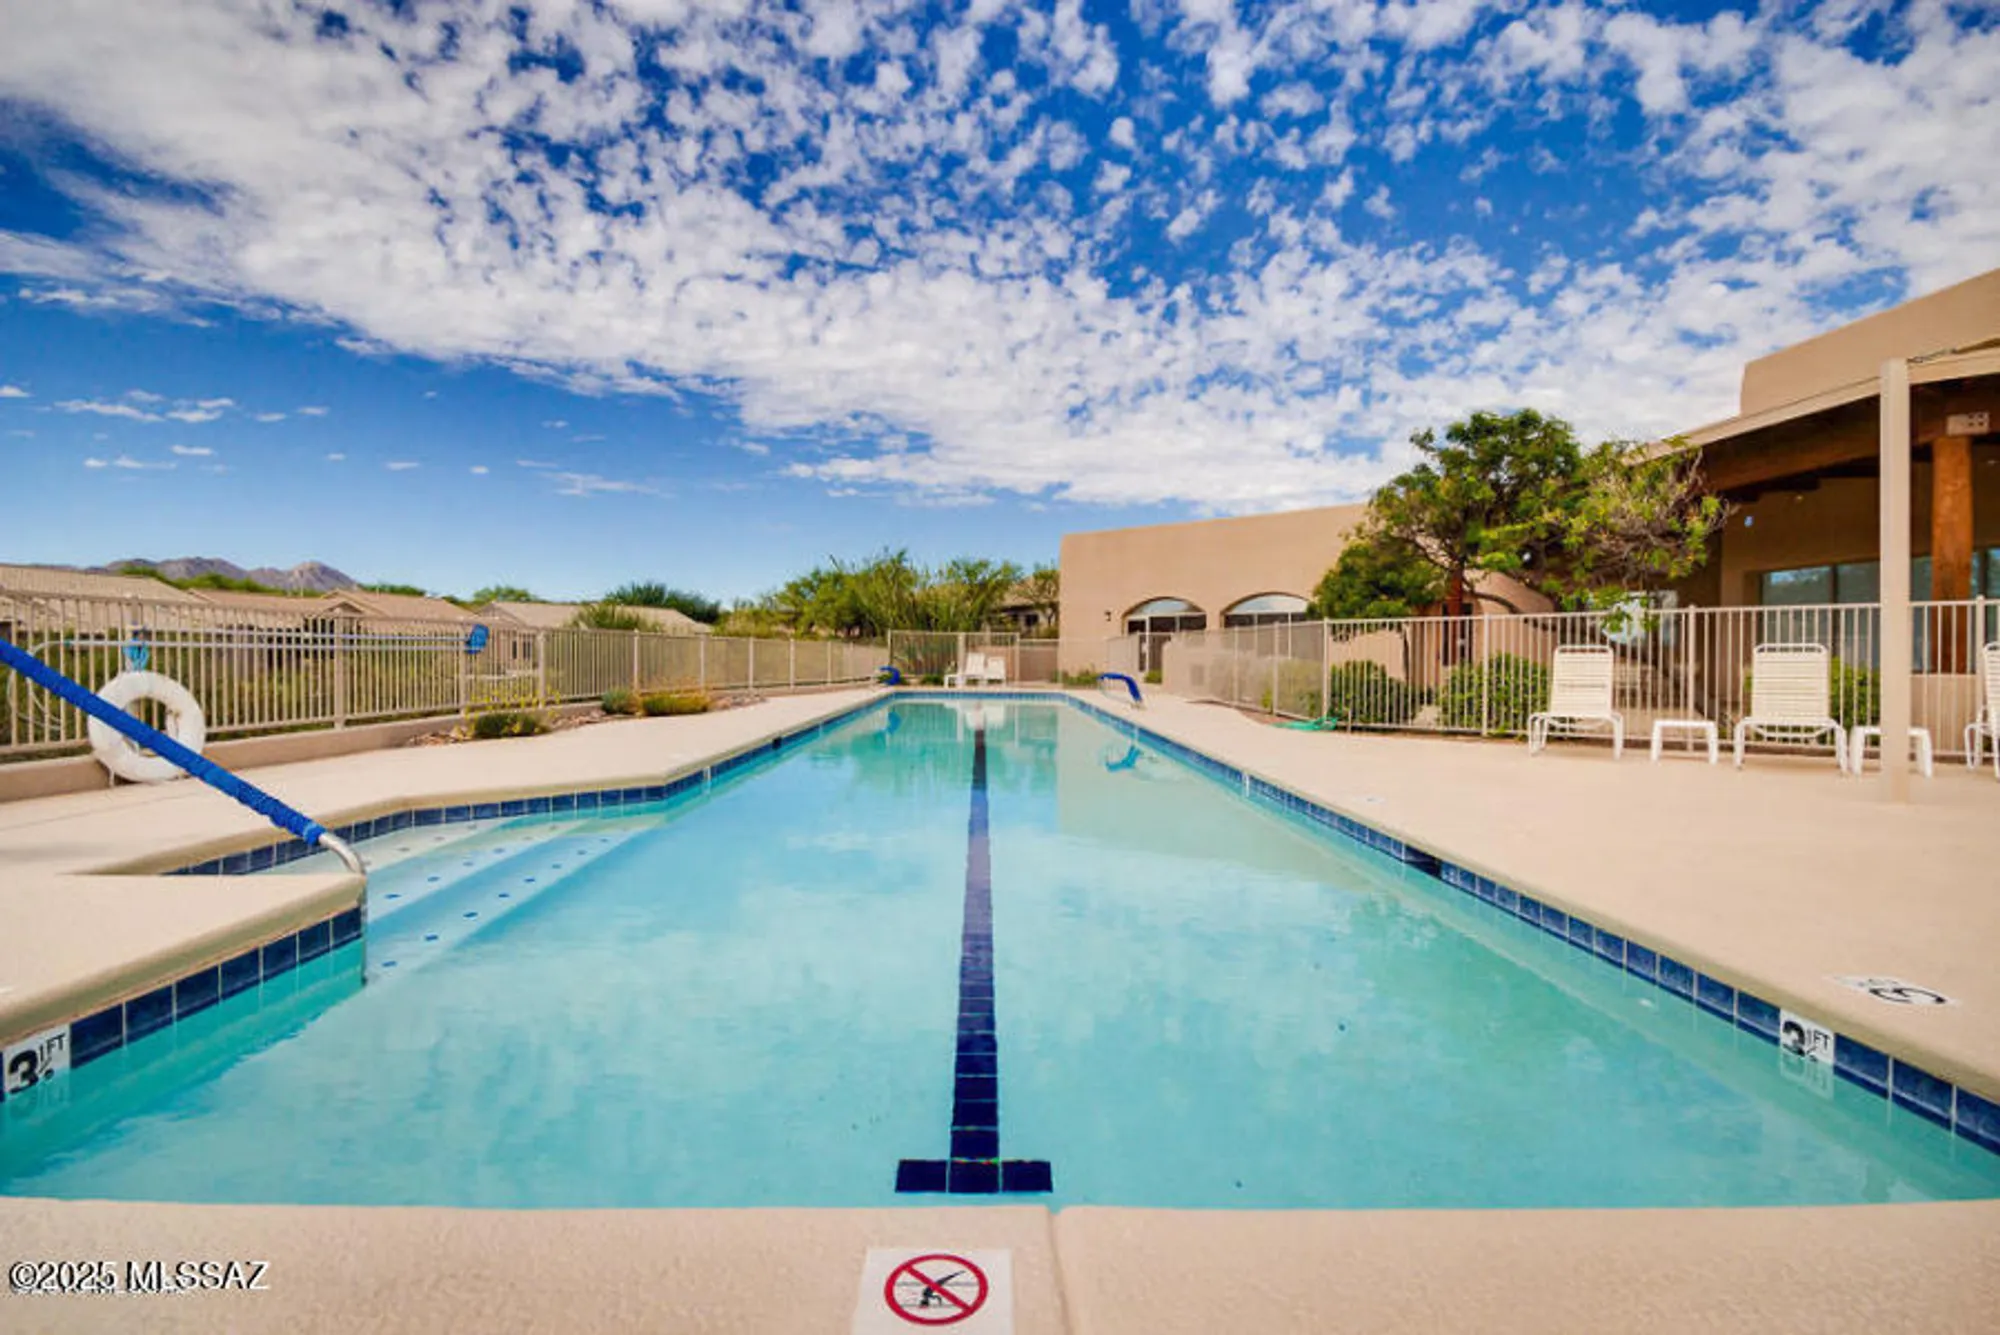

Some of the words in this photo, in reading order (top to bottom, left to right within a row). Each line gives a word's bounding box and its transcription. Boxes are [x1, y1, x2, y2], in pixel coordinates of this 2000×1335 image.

[8, 1049, 39, 1095] 3
[46, 1032, 66, 1054] FT
[1782, 1020, 1805, 1057] 3
[1813, 1029, 1830, 1051] FT
